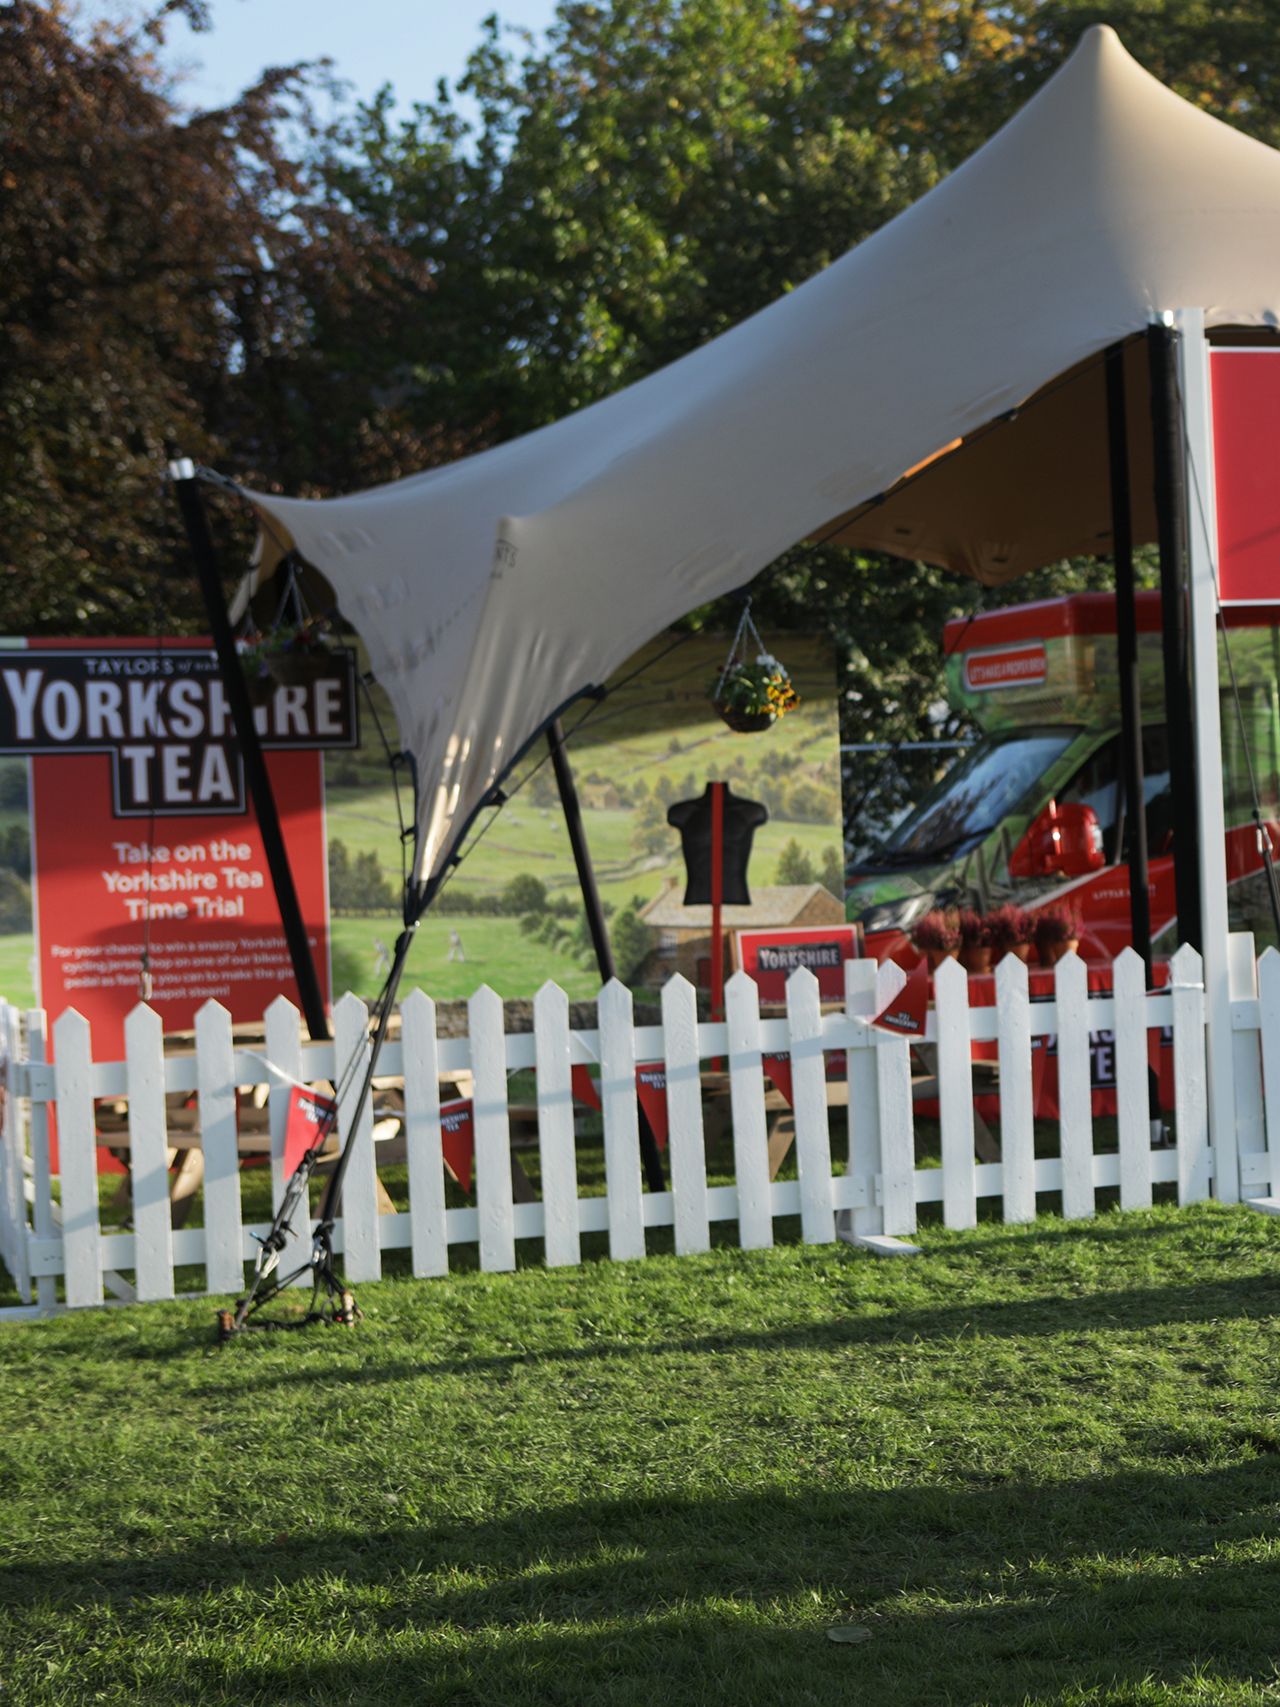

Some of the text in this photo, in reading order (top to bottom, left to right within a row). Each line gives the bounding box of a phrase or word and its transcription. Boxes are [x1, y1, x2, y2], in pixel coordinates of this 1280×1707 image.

[122, 745, 235, 802] TEA
[113, 839, 251, 864] Take on the
[102, 867, 264, 893] Yorkshire Tea
[124, 895, 244, 921] Time Trial
[240, 938, 288, 949] Yorkshir
[759, 948, 840, 970] YORKSHIRE
